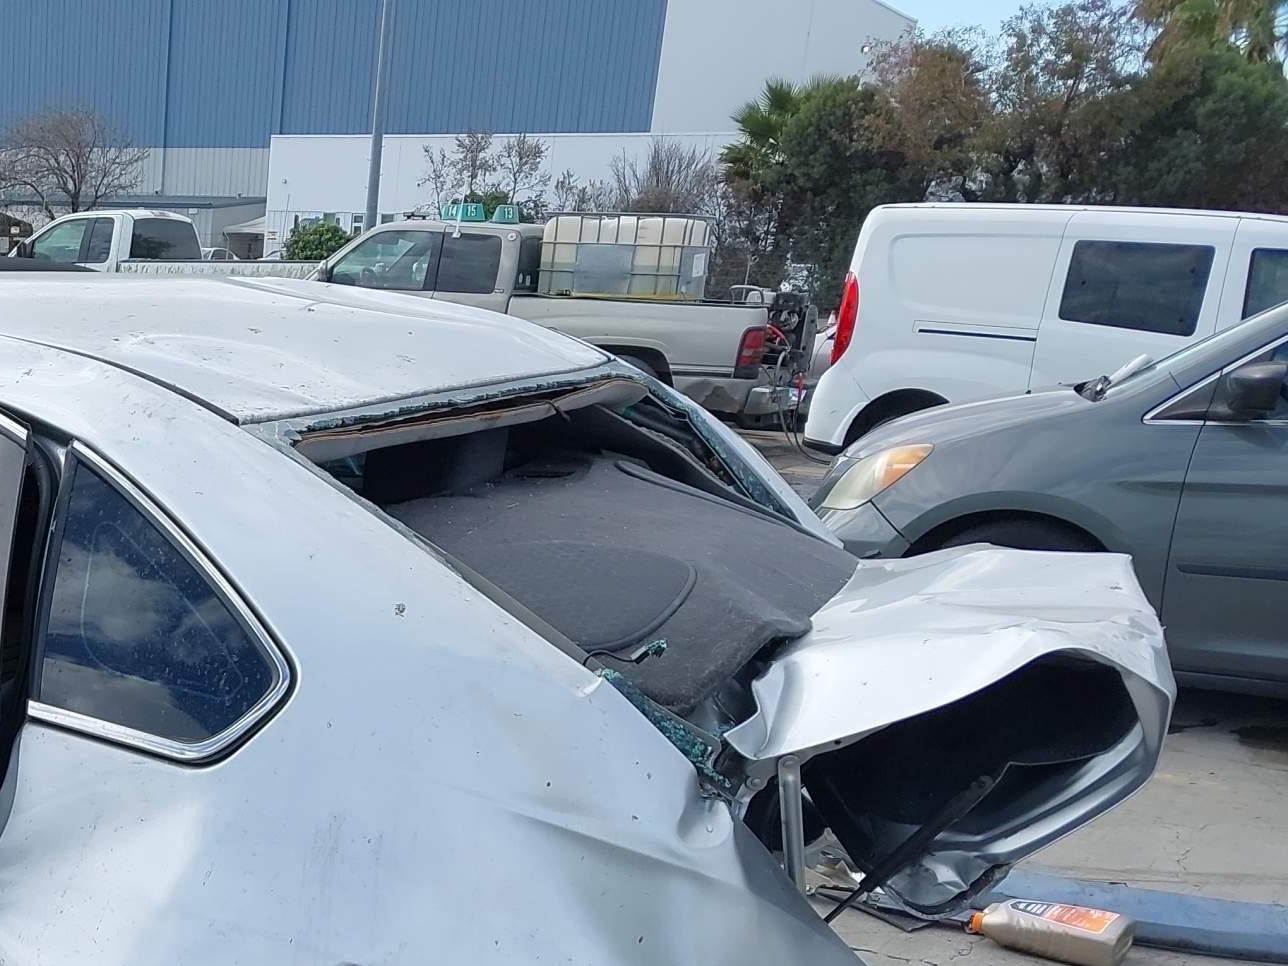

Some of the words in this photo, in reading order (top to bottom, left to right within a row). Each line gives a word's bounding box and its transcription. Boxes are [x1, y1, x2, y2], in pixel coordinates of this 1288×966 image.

[448, 205, 457, 217] 14
[467, 205, 477, 217] 15
[504, 207, 513, 219] 13
